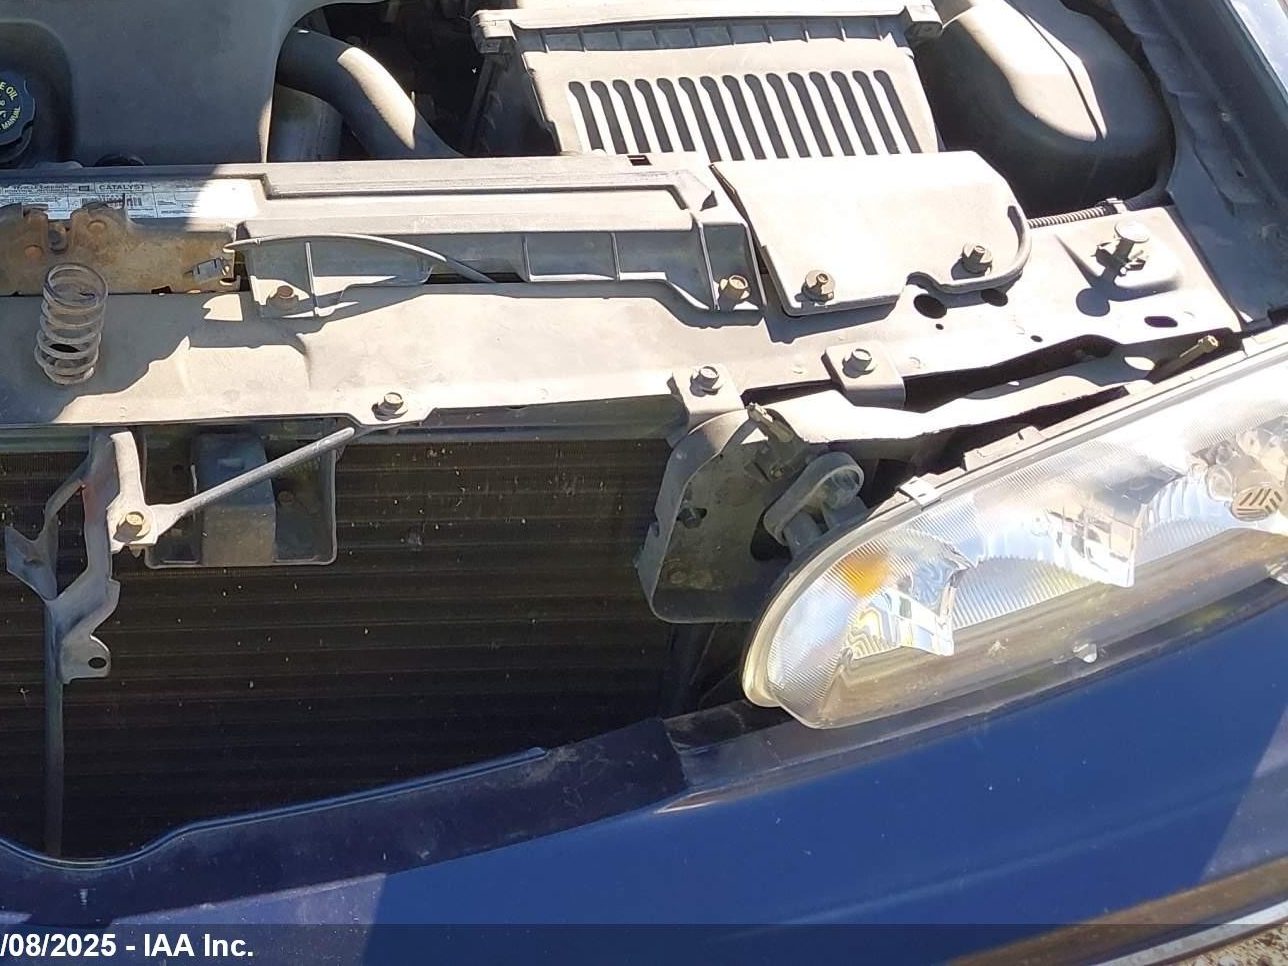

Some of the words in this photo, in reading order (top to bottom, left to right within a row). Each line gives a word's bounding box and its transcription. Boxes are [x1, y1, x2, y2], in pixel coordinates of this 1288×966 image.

[5, 85, 18, 101] OIL
[1, 105, 21, 130] MANUAL
[98, 184, 145, 192] CATALYST
